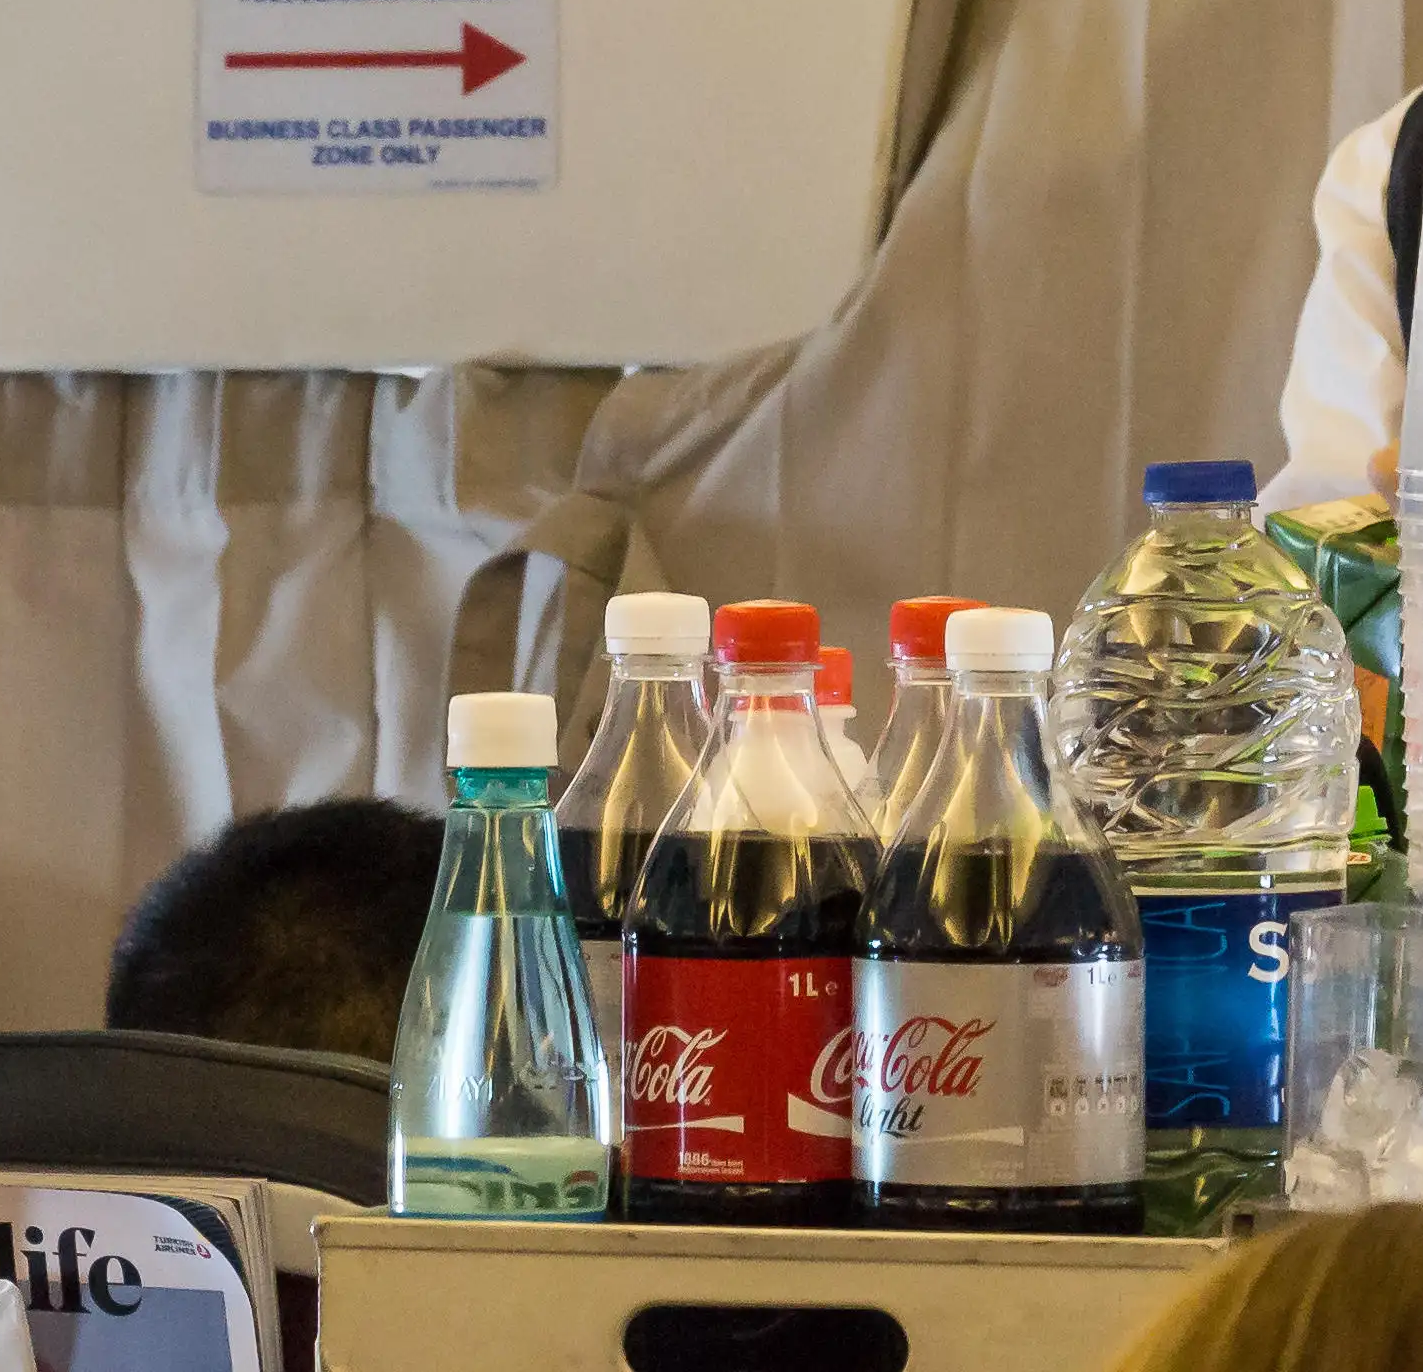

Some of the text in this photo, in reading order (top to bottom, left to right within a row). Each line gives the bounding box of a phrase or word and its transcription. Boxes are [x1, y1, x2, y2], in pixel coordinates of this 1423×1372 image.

[207, 117, 547, 140] BUSINESS CLASS PASSENGER
[311, 145, 441, 166] ZONE ONLY
[153, 1235, 194, 1248] TURKISH
[155, 1244, 197, 1256] AIRLINES
